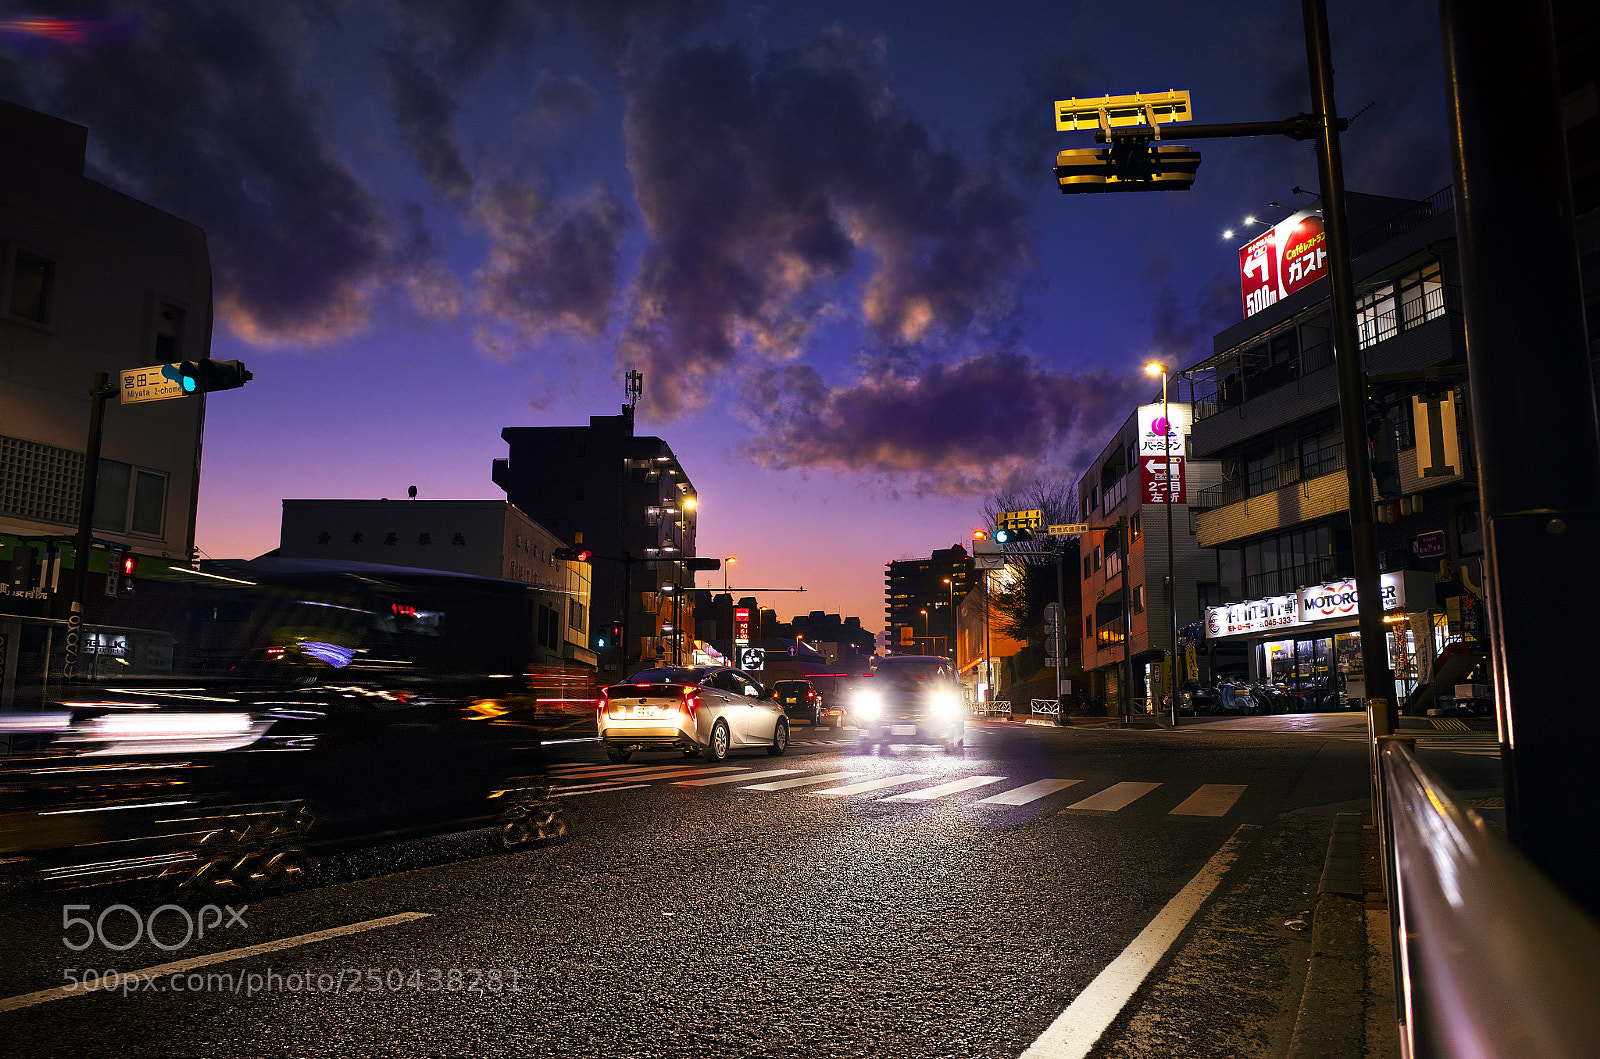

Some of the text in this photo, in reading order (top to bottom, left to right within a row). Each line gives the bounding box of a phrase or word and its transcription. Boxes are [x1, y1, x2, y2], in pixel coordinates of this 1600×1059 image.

[1288, 247, 1327, 286] ガスト
[1246, 285, 1277, 318] 500m
[127, 388, 150, 399] Miyata
